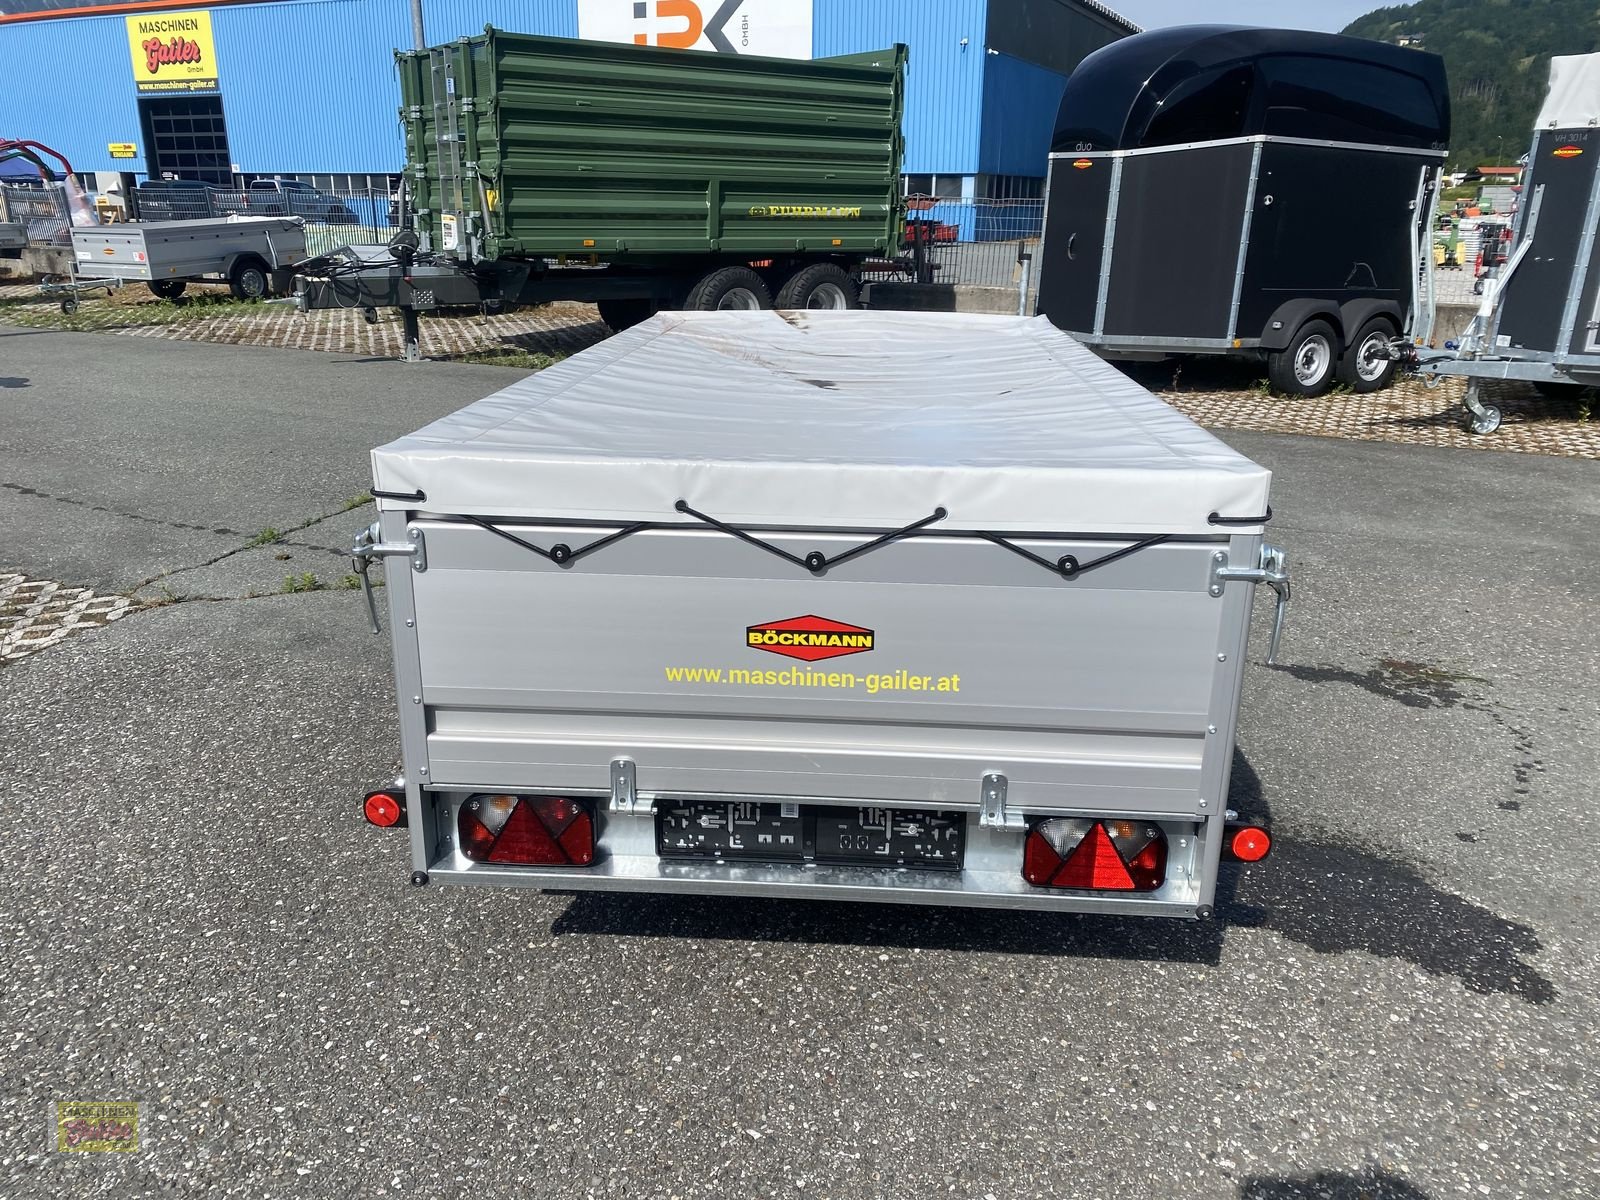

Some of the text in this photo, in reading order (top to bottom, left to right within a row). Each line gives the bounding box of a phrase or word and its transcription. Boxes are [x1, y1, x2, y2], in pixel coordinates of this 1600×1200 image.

[138, 18, 198, 33] MASCHINEN
[741, 15, 749, 46] GMBH
[142, 36, 201, 74] Gailer
[138, 79, 215, 91] www.maschinen-gailer.at
[1555, 133, 1588, 142] VH 3014
[1075, 141, 1093, 152] duo
[768, 205, 862, 217] FUHRMANN
[748, 630, 873, 647] BÖCKMANN
[665, 666, 961, 694] www.maschinen-gailer.at
